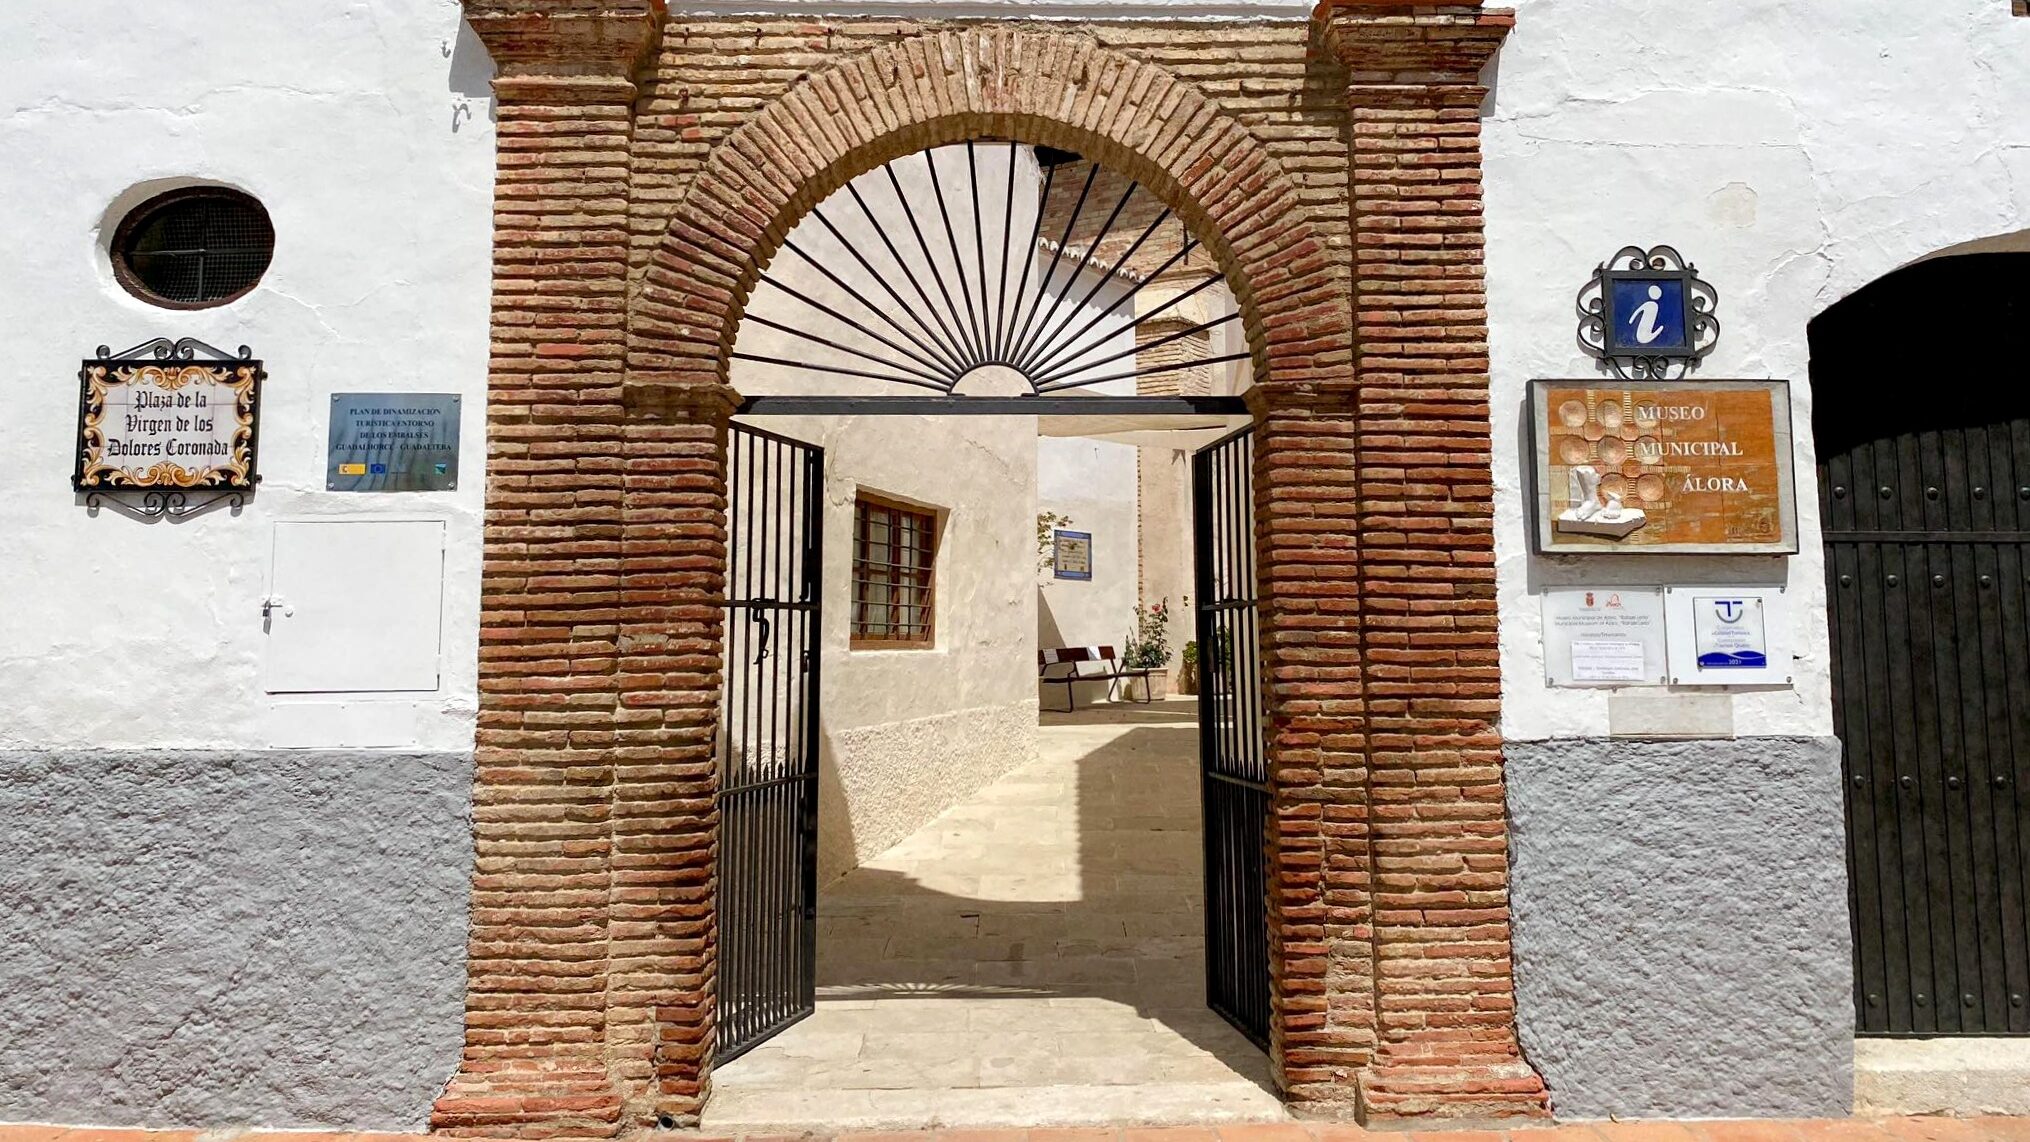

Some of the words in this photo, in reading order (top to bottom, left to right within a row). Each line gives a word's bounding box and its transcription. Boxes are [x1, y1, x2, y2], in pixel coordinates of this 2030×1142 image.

[134, 390, 173, 412] Plaza
[177, 392, 191, 408] de
[195, 391, 207, 408] la
[383, 407, 441, 415] DINAMIZACIÓN
[1637, 406, 1705, 420] MUSEO
[125, 414, 172, 435] Virgen
[176, 415, 190, 432] de
[194, 415, 214, 432] los
[356, 419, 396, 427] TURÍSTICA
[107, 438, 162, 457] Dolores
[165, 438, 228, 456] Coronada
[1640, 441, 1744, 456] MUNICIPAL
[1682, 474, 1748, 492] ÁLORA
